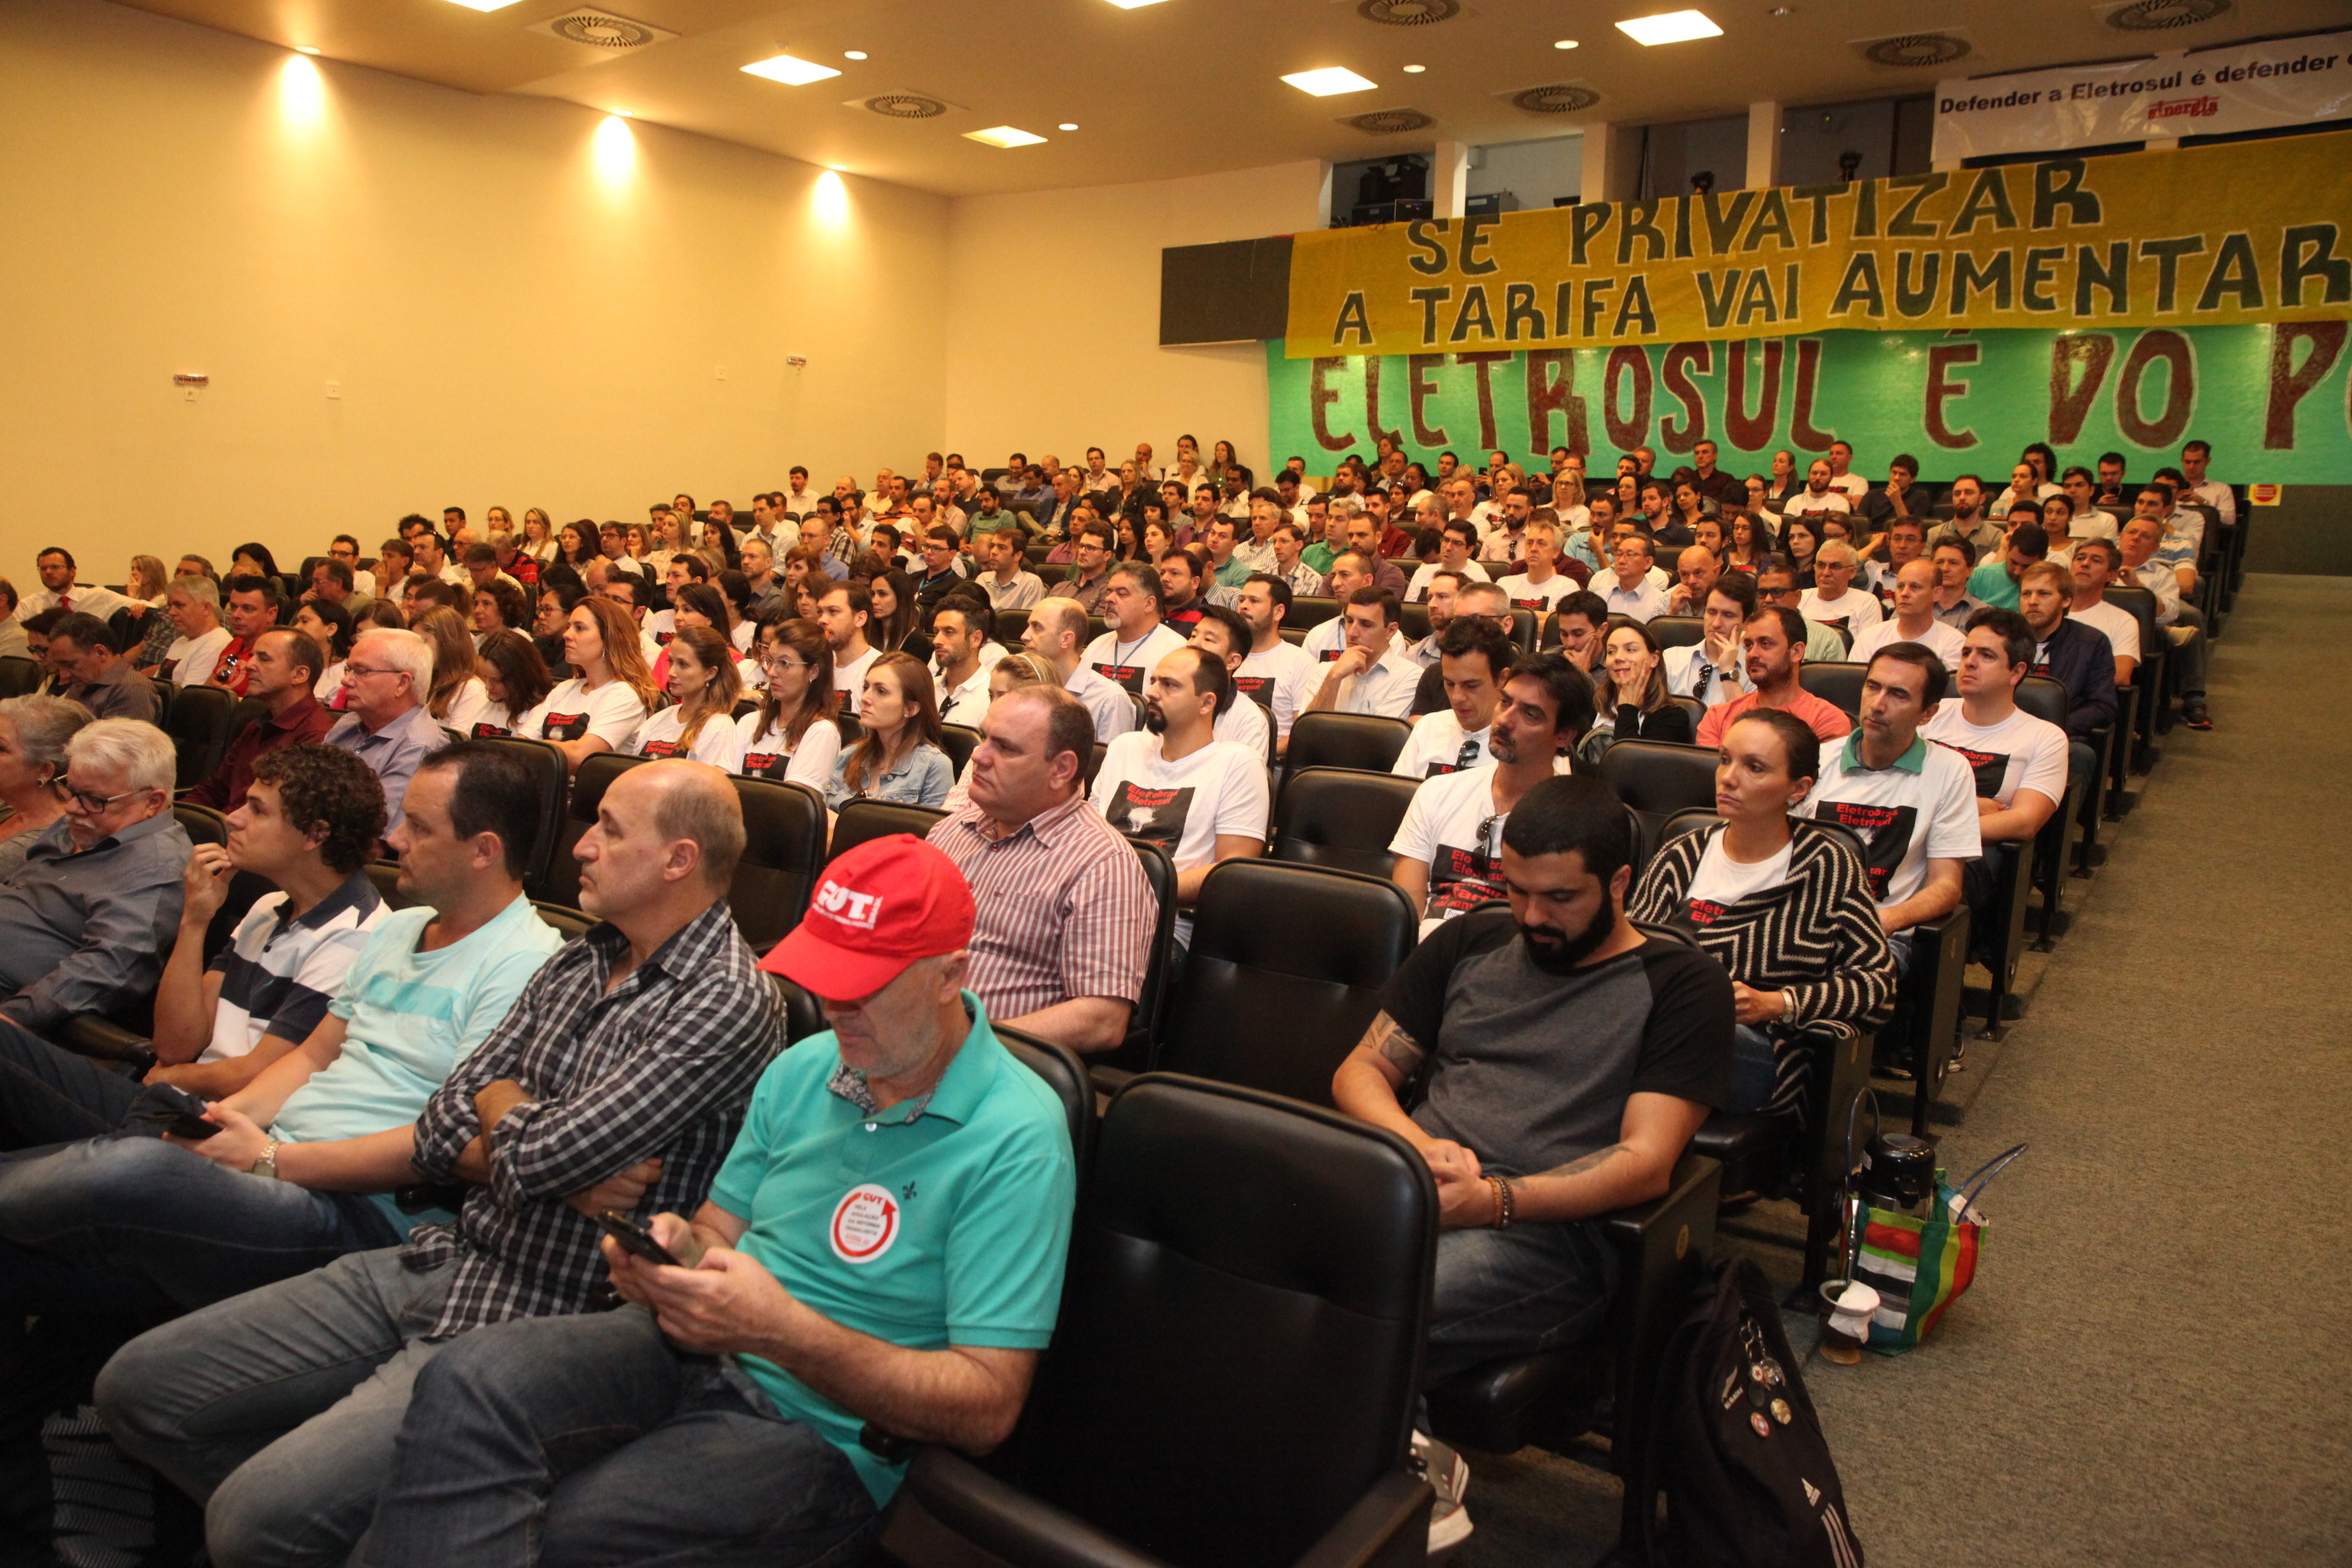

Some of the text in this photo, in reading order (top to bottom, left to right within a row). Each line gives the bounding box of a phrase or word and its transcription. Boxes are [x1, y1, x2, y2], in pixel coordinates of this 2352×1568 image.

[1940, 90, 2041, 113] Defender
[2049, 89, 2062, 101] a
[2071, 72, 2182, 100] Eletrosul
[2191, 69, 2206, 85] é
[2215, 55, 2338, 83] defender
[1407, 158, 2104, 275] SE PRIVATIZAR
[1332, 220, 2352, 346] A TARIFA VAI AUMENTAR
[1309, 337, 1838, 457] ELETROSUL
[2046, 326, 2199, 453] DO
[1837, 803, 1898, 817] Eletrobras
[1839, 814, 1892, 827] Eletrosul
[817, 879, 874, 920] CUT
[863, 1193, 883, 1205] CUT
